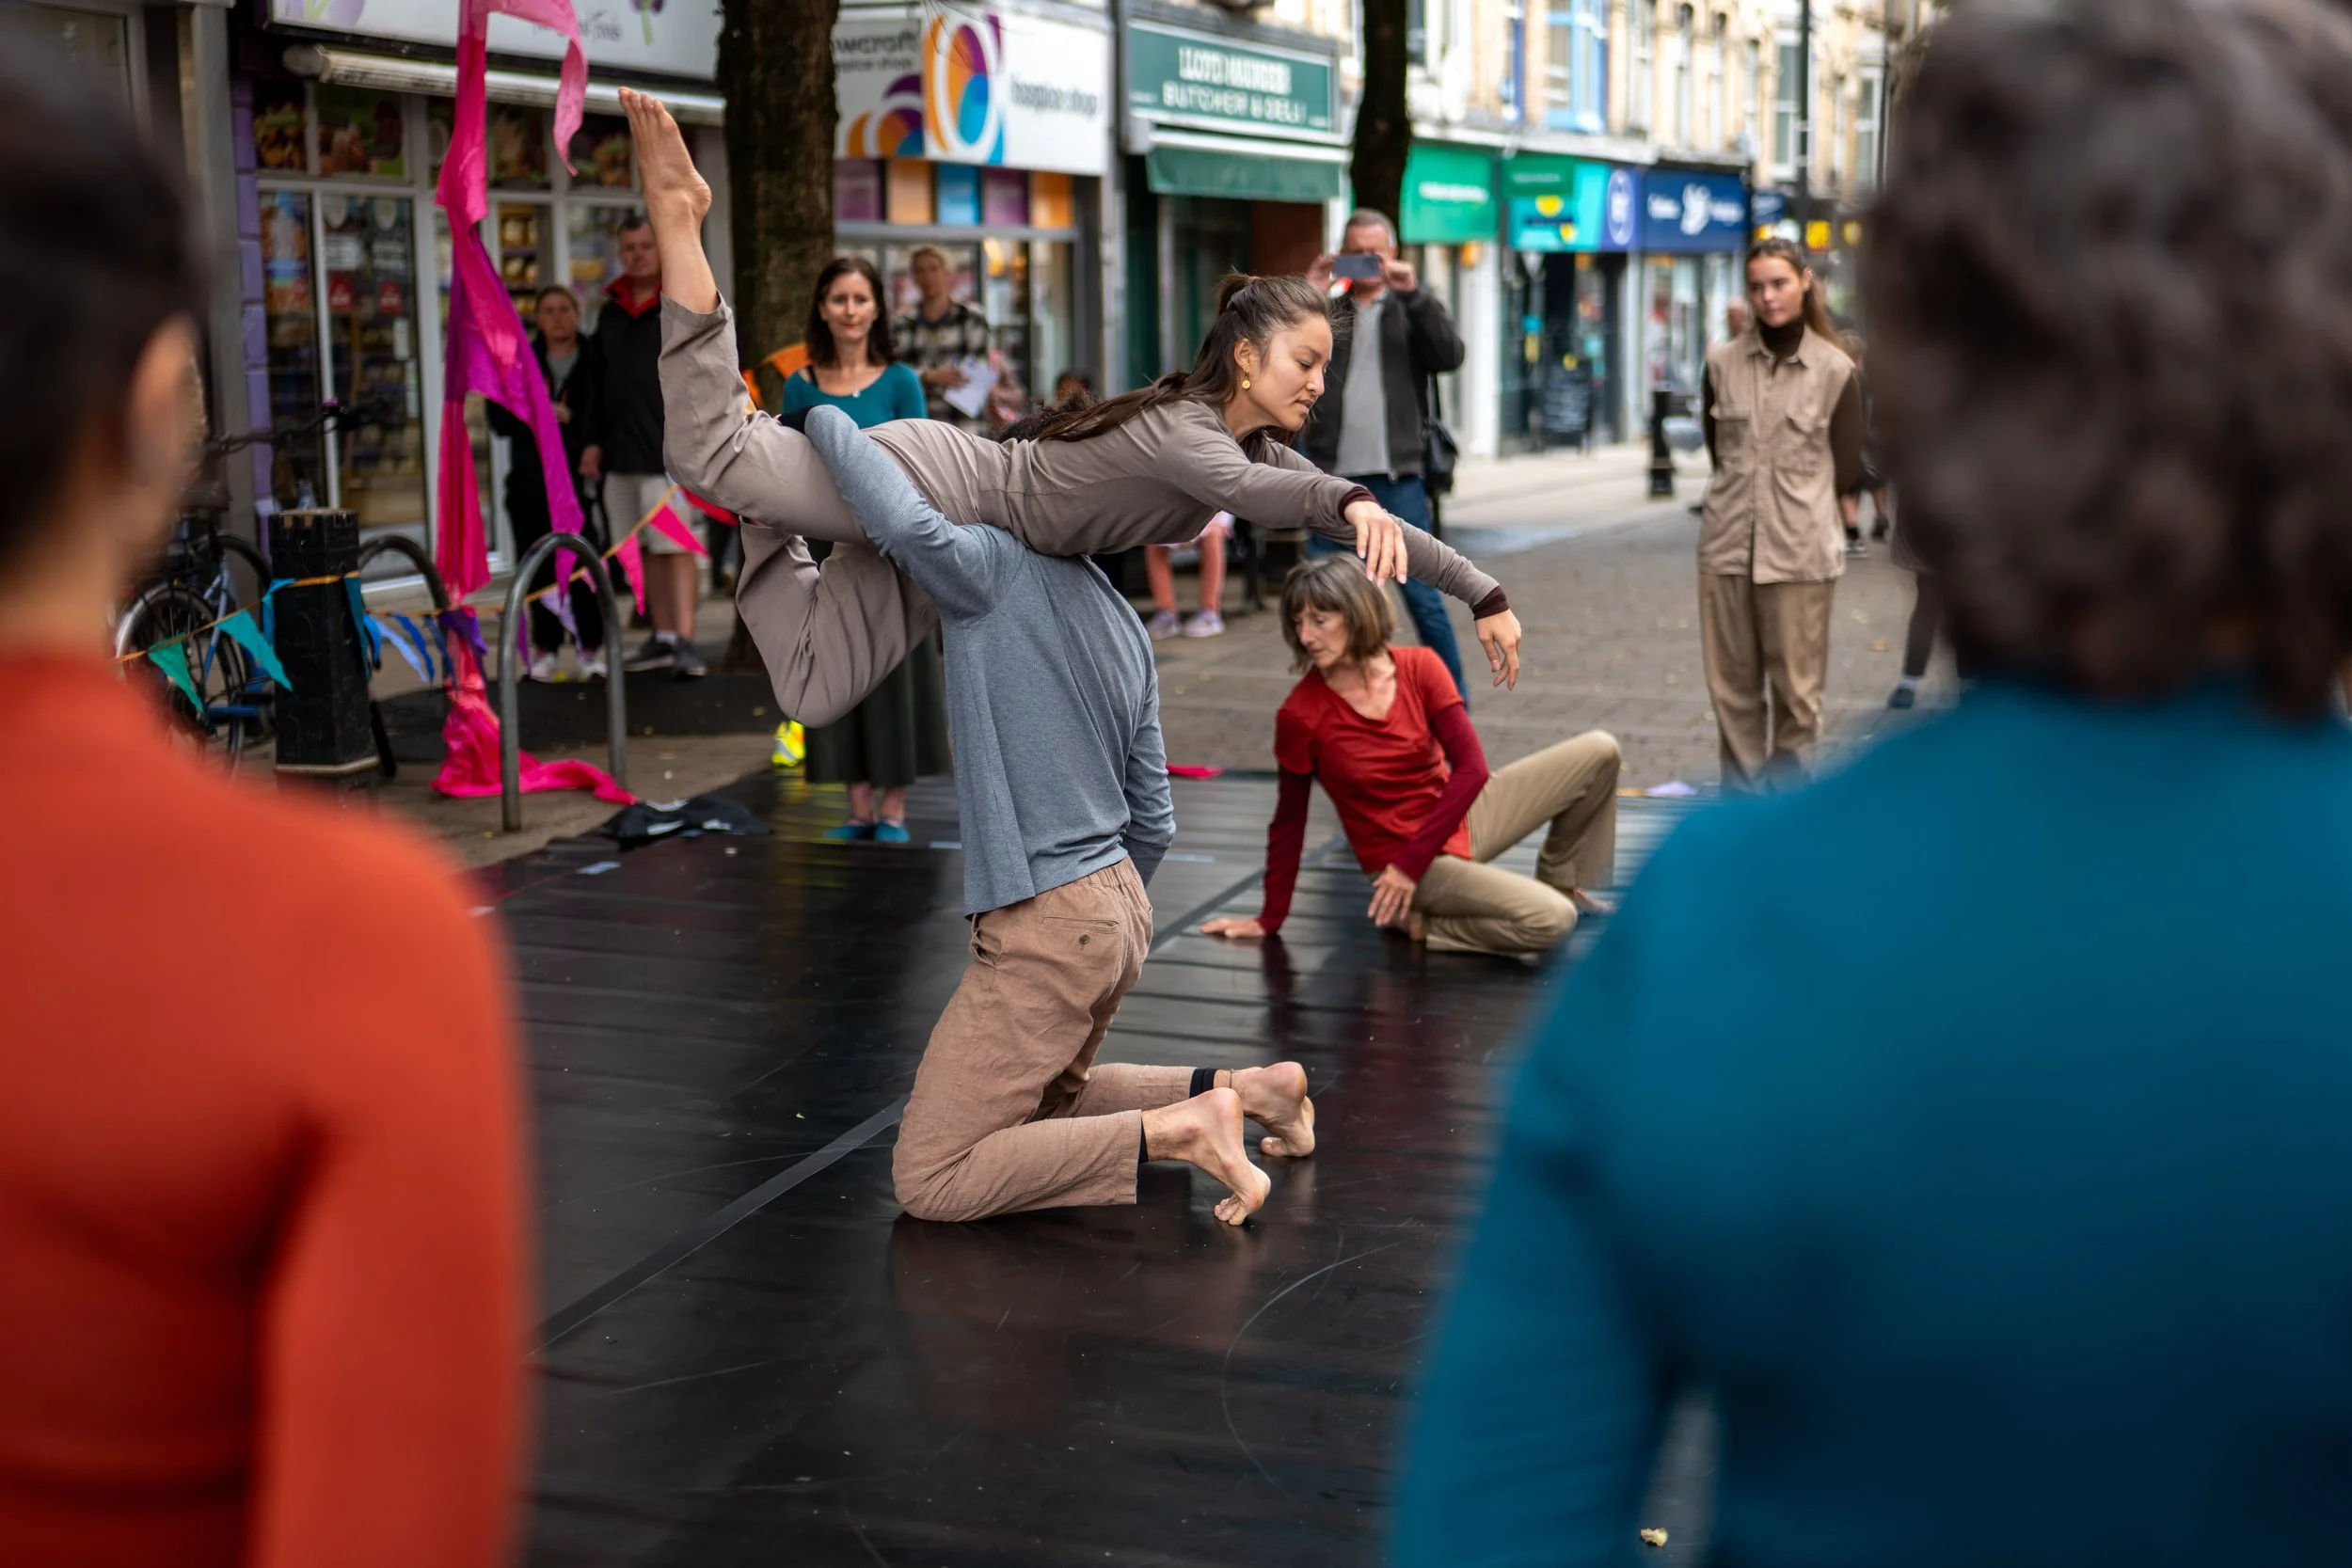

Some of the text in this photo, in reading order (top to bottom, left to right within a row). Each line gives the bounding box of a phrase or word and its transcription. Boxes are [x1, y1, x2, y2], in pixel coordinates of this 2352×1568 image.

[833, 30, 918, 55] wcroft
[1179, 46, 1225, 85] LLOYD
[1010, 73, 1097, 120] hospice shop
[1162, 79, 1248, 116] BUTCHER
